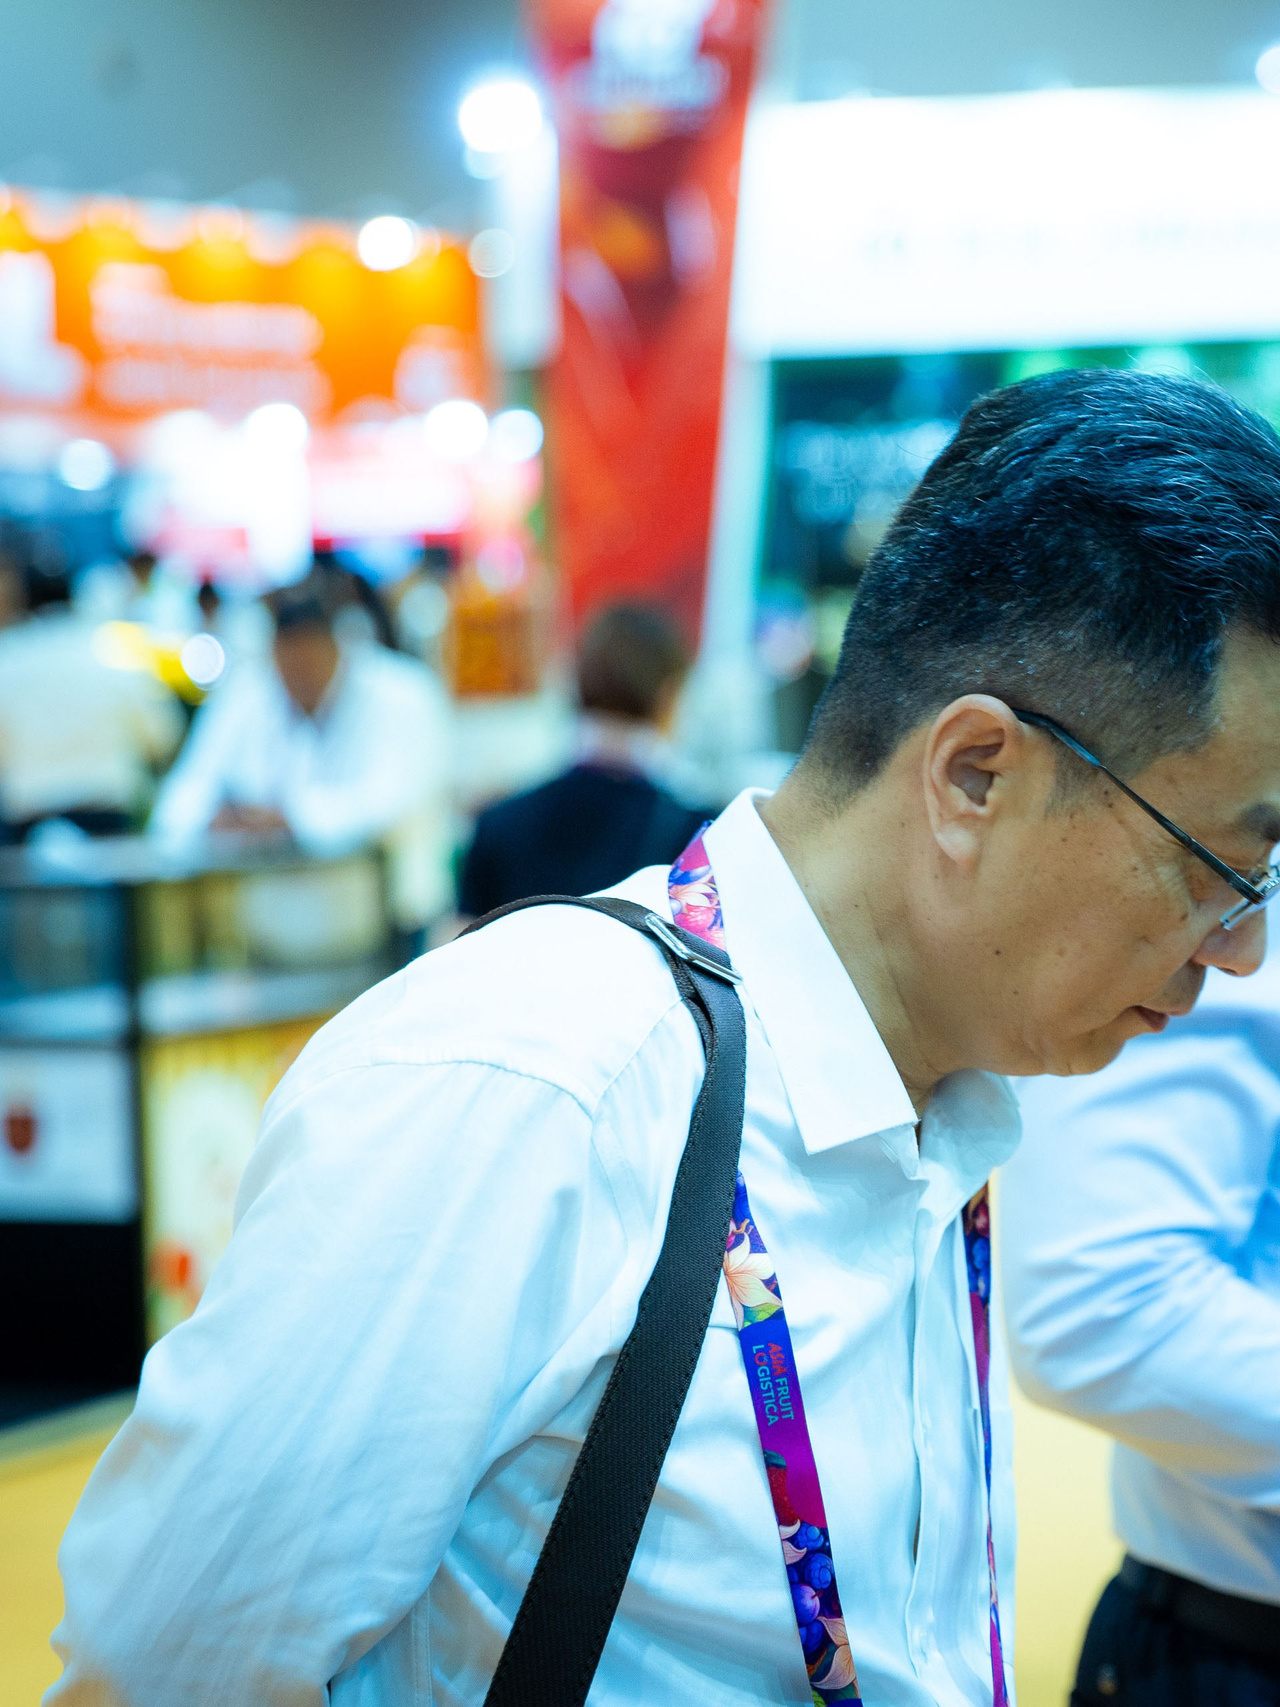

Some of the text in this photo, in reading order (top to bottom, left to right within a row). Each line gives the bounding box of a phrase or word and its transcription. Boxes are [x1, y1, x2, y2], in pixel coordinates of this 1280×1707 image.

[752, 1344, 779, 1426] LOGISTICA
[768, 1343, 794, 1420] ASIA FRUIT
